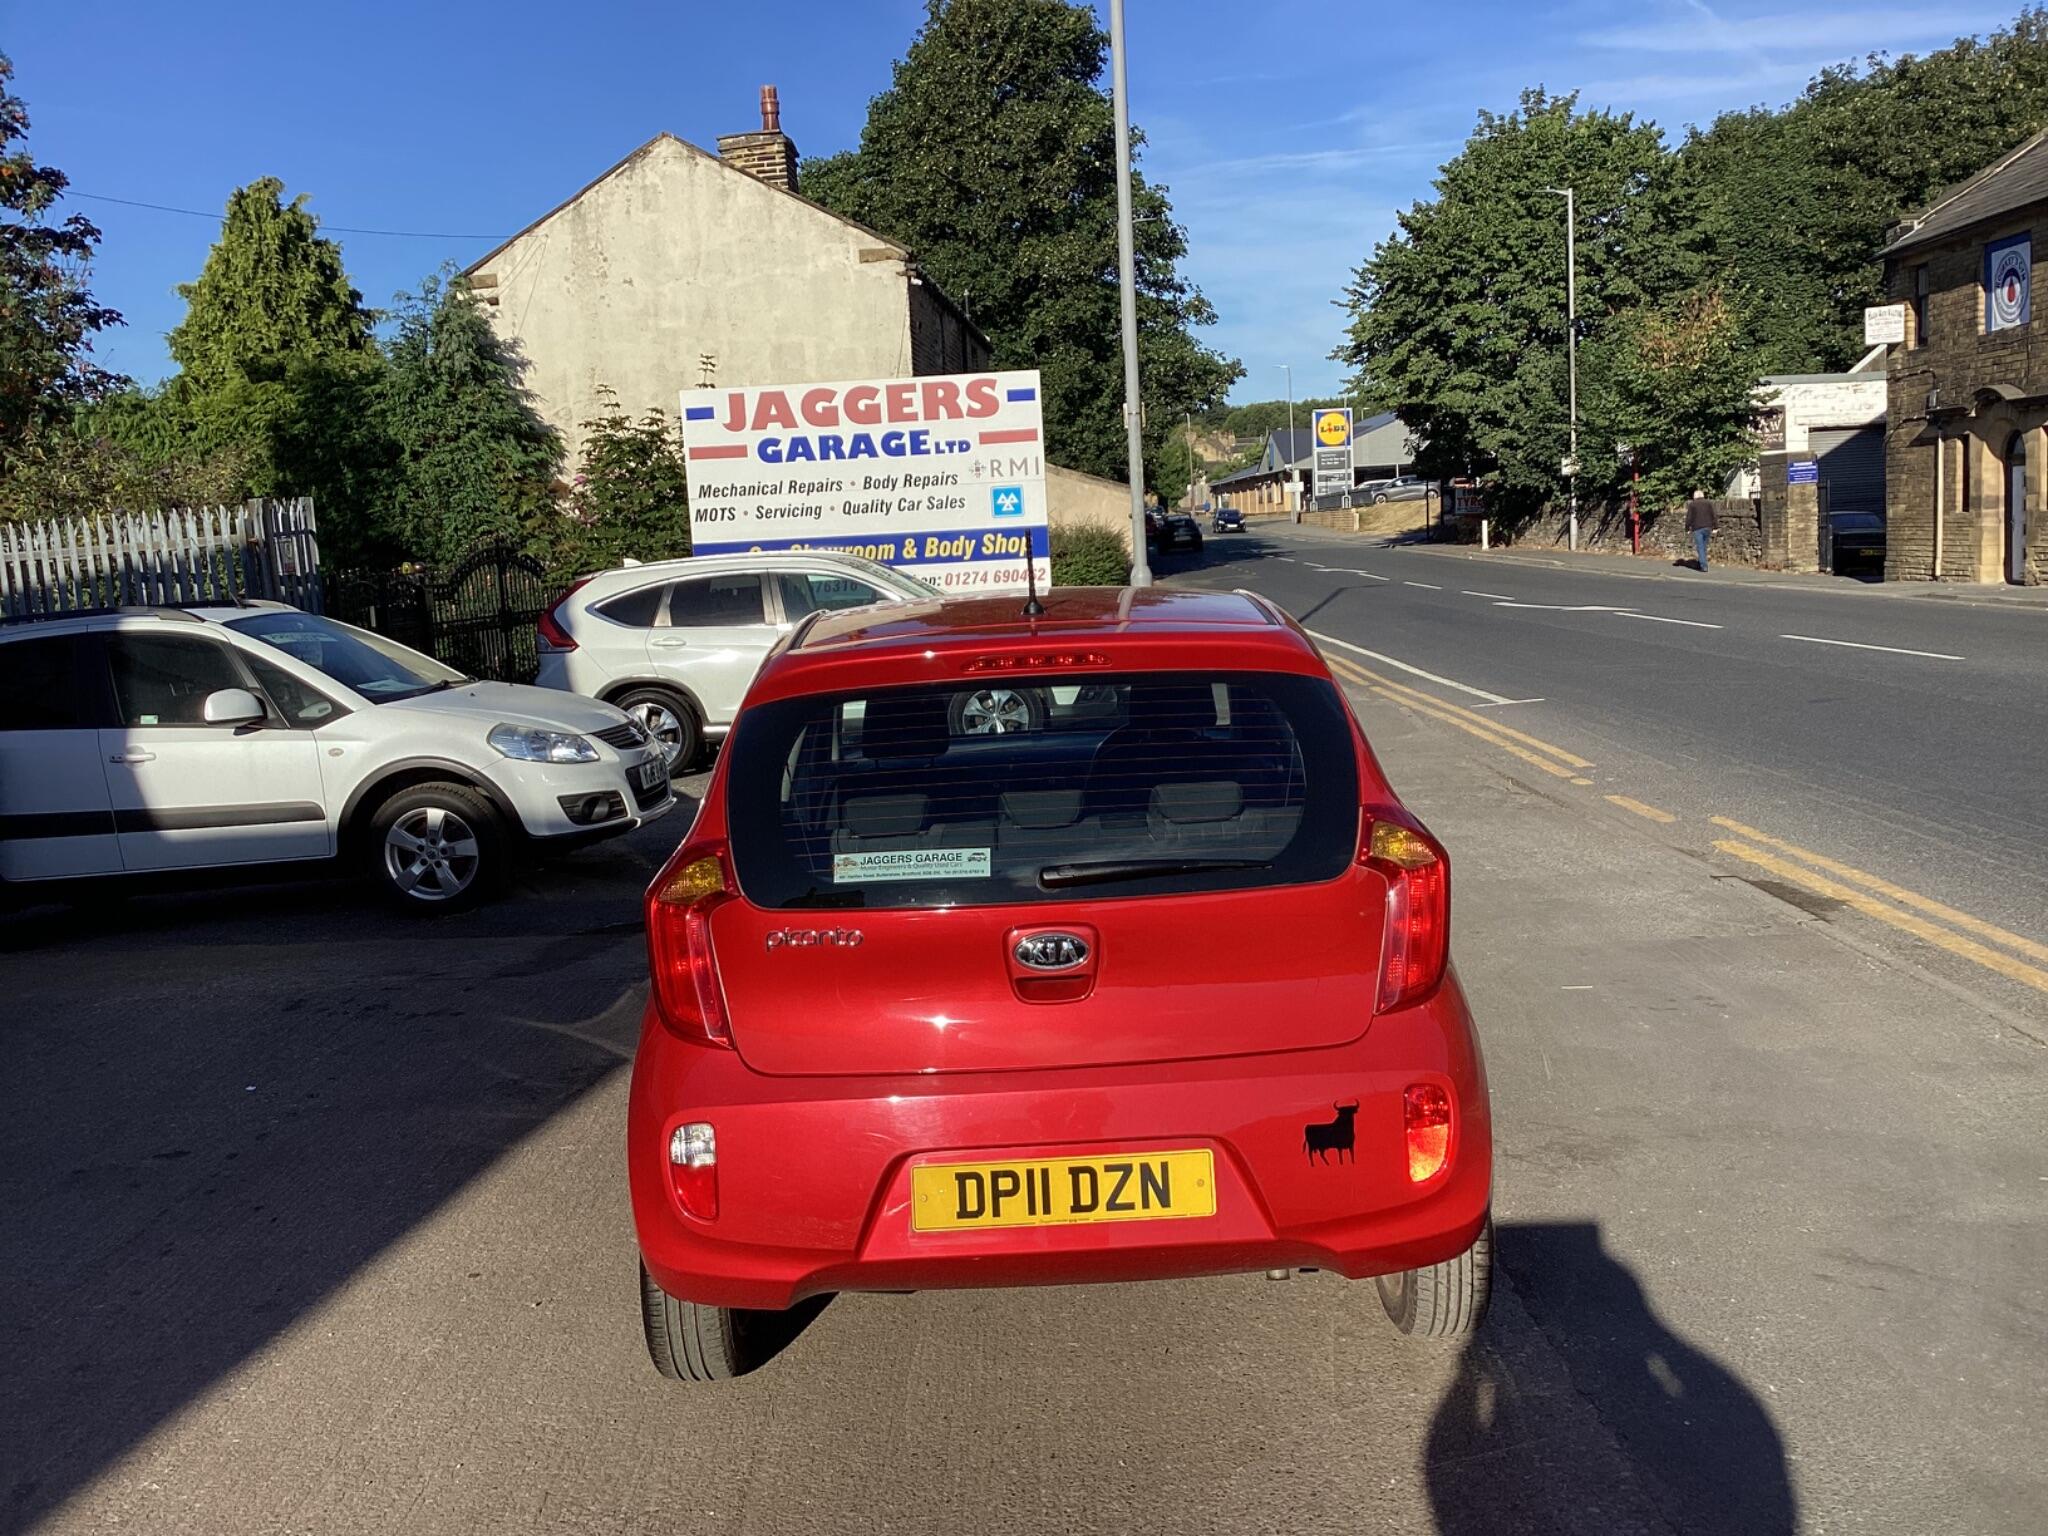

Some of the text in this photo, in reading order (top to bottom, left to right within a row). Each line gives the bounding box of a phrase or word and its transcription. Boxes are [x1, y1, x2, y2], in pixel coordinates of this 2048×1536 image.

[722, 378, 1000, 432] JAGGERS
[756, 429, 971, 464] GARAGE LTD
[989, 457, 1040, 478] RMI
[699, 472, 959, 499] Mechanical Repairs Body Repairs
[695, 495, 966, 523] MOTS Servicing Quality Car Sales
[902, 537, 918, 559] &
[925, 535, 976, 561] Body
[981, 533, 1029, 557] Shop
[944, 570, 988, 587] 01274
[860, 852, 963, 866] JAGGERS GARAGE
[766, 926, 864, 952] picanto
[955, 1161, 1172, 1220] DP11 DZN
